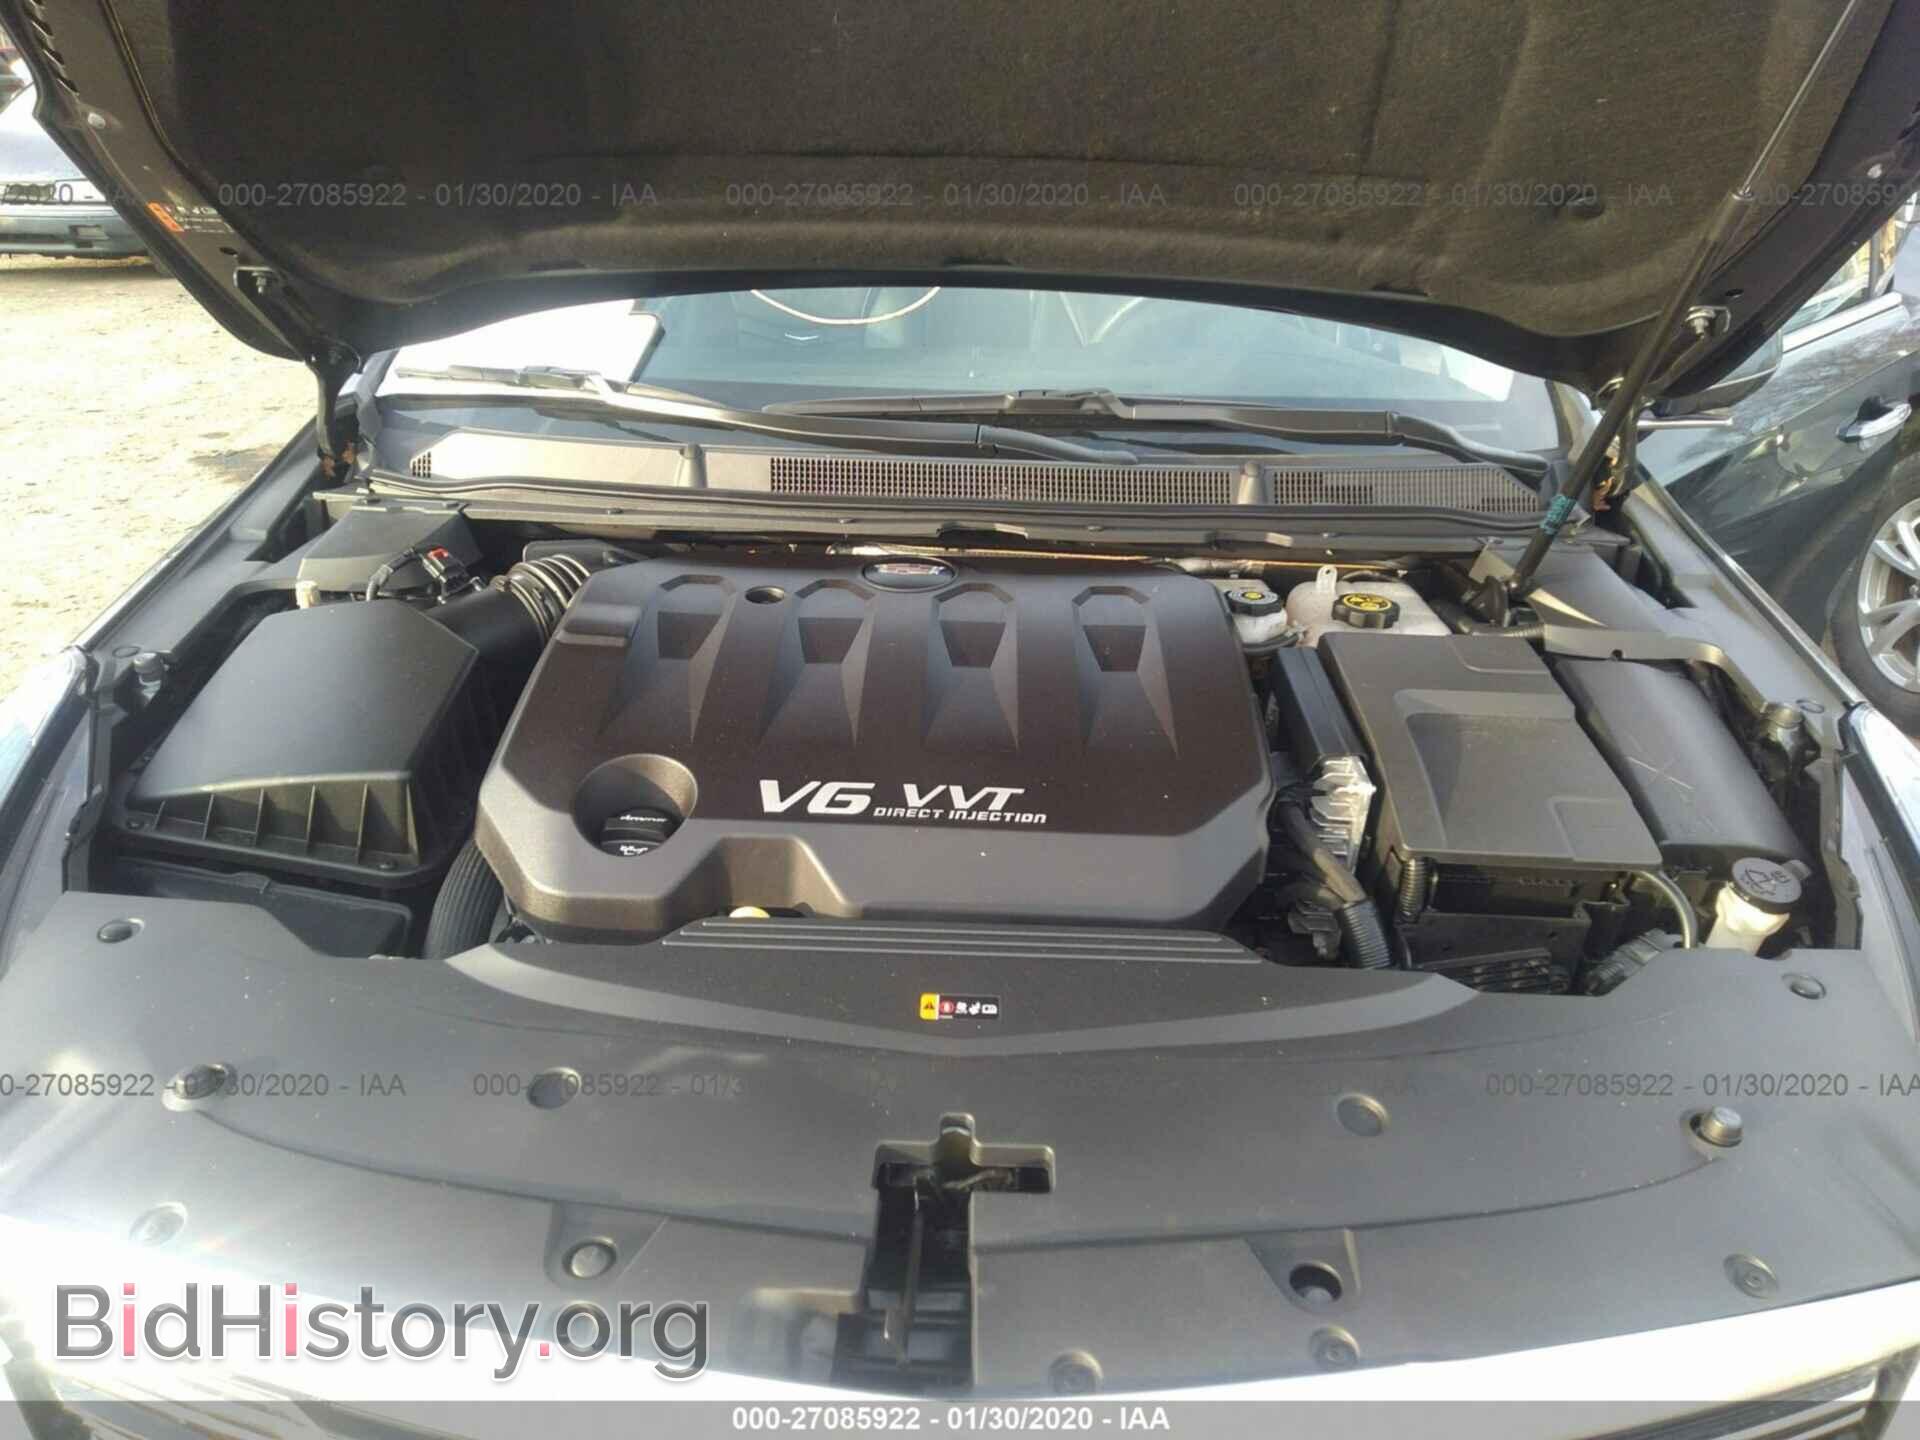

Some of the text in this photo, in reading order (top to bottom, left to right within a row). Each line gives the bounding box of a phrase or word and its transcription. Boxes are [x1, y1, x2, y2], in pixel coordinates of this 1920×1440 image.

[759, 779, 1025, 815] V6 VVT
[873, 807, 1047, 824] DIRECT INJECTION
